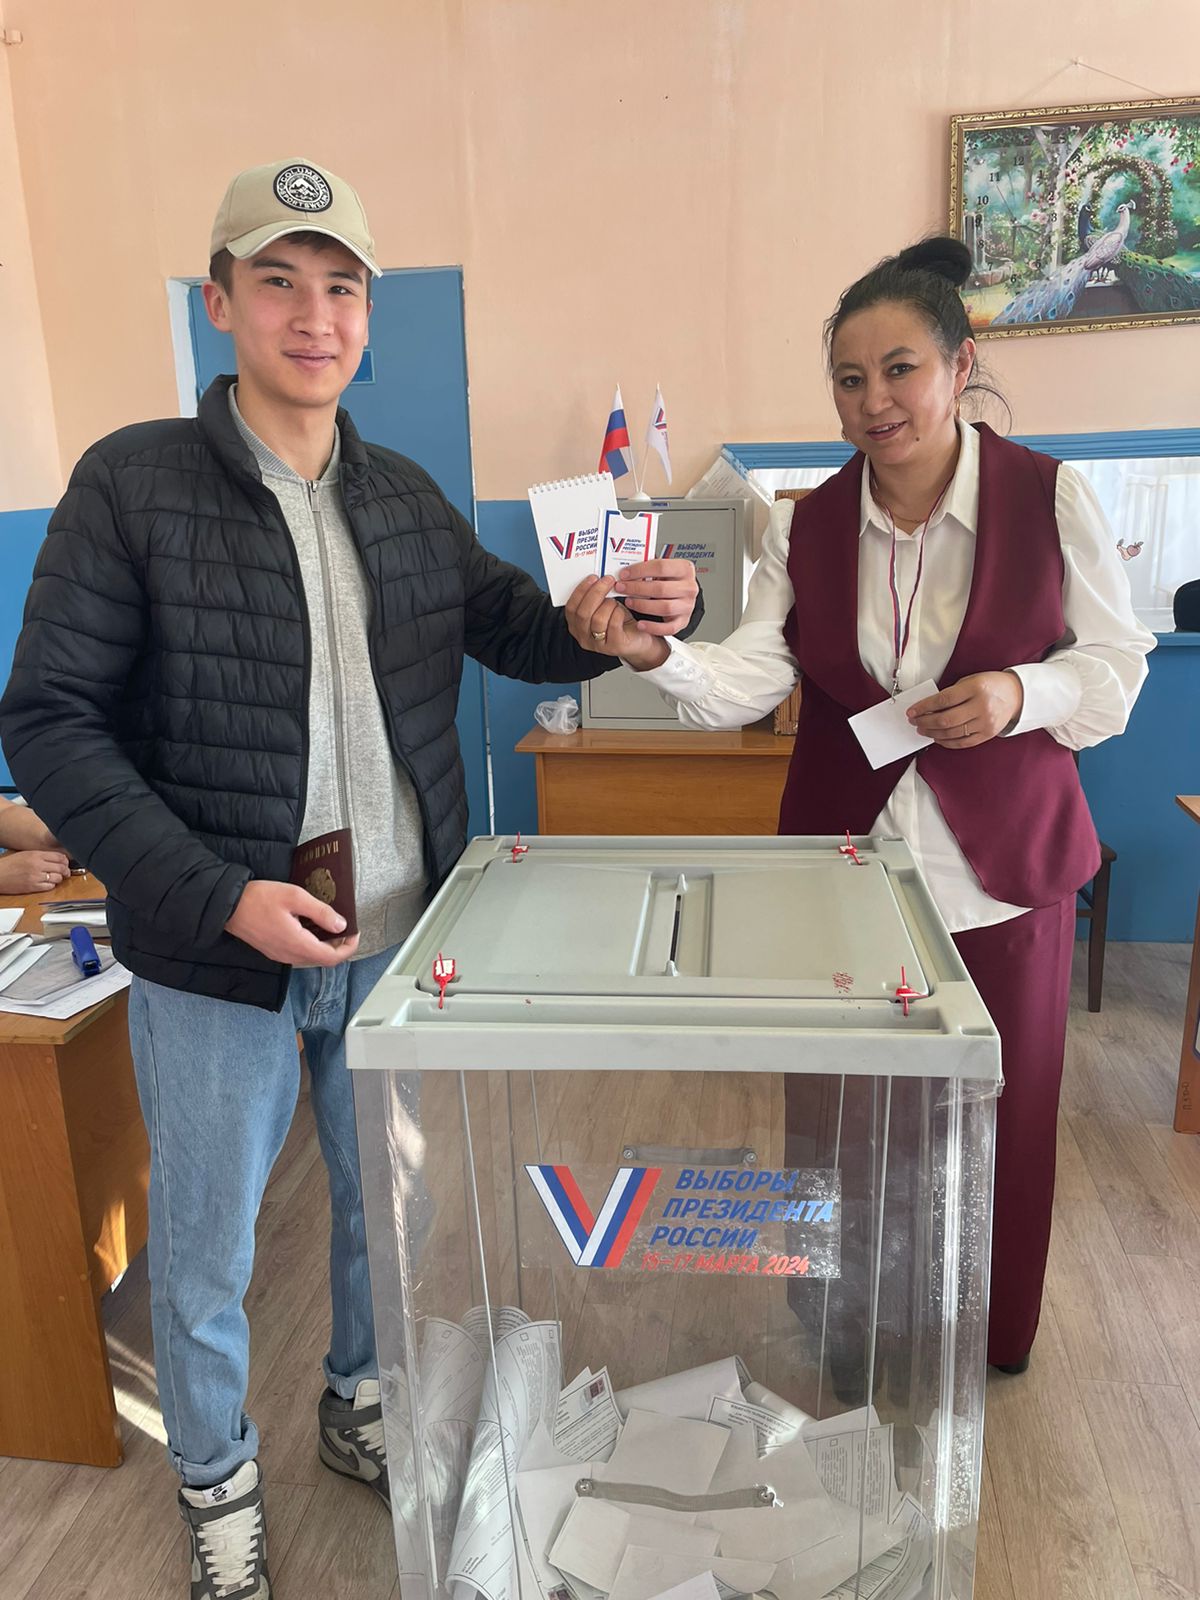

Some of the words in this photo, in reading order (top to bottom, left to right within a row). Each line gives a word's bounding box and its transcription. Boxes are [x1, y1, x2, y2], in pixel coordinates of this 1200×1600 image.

[1013, 156, 1025, 166] 12
[280, 167, 327, 190] COLUMBIA
[989, 172, 1001, 182] 11
[977, 195, 989, 205] 10
[578, 527, 599, 537] ВЫБОР
[673, 551, 715, 559] ПРЕЗИДЕНТА
[677, 543, 707, 551] ВЫБОРЫ
[302, 840, 339, 863] ПАСПОР
[675, 1168, 799, 1192] ВЫБОРЫ
[662, 1198, 834, 1223] ПРЕЗИДЕНТА
[649, 1225, 759, 1249] РОССИИ
[695, 1253, 759, 1275] МАРТА
[762, 1255, 810, 1275] 2024
